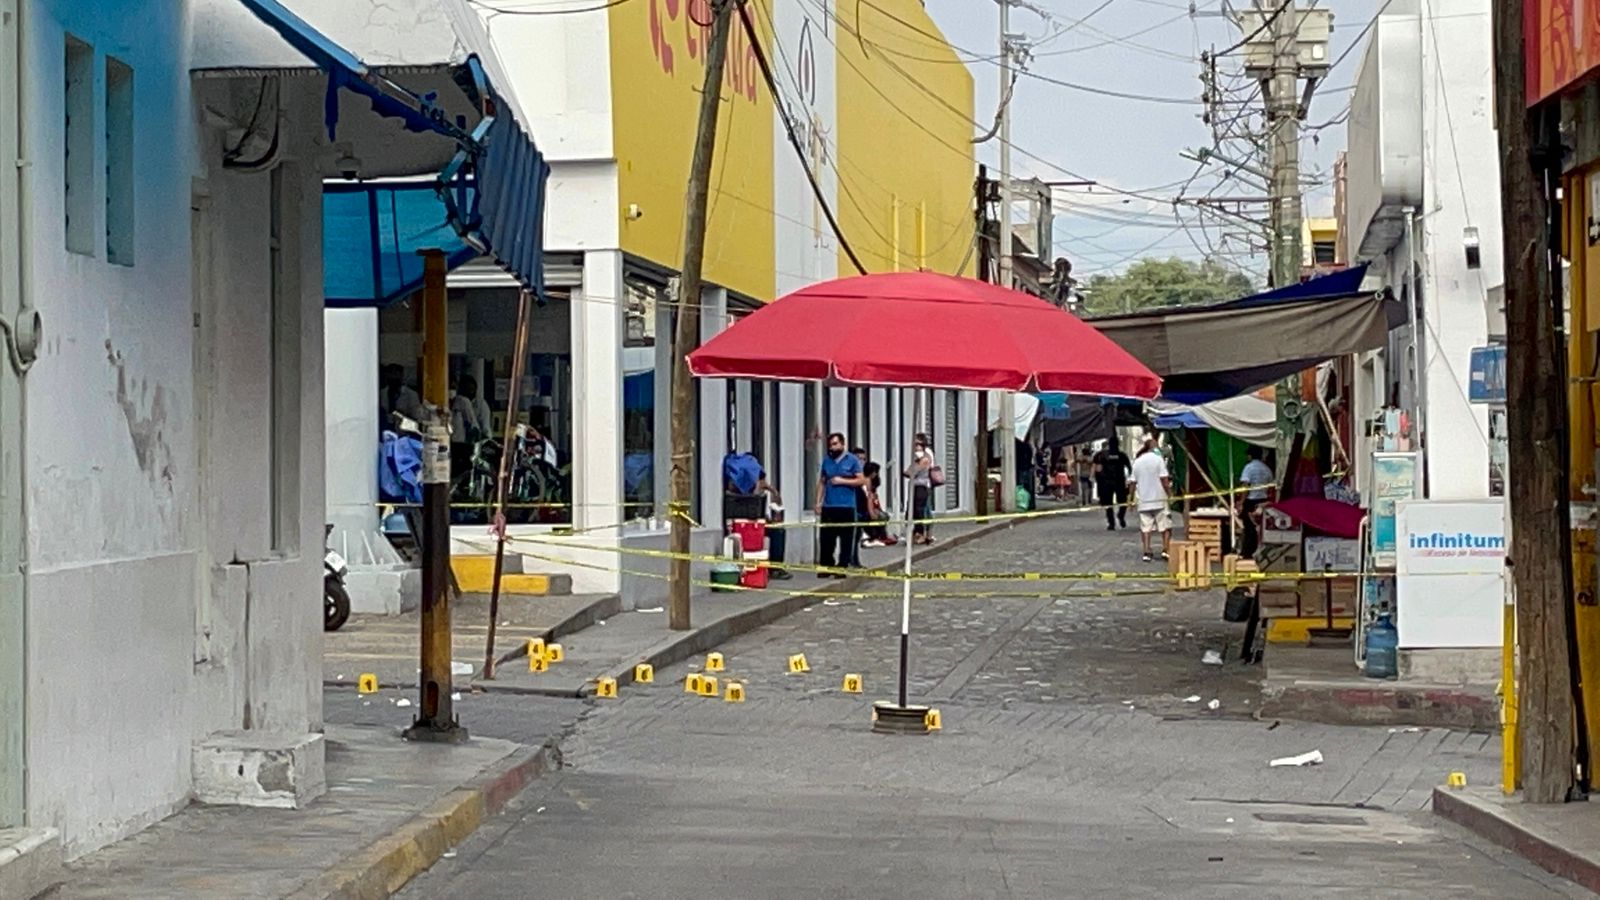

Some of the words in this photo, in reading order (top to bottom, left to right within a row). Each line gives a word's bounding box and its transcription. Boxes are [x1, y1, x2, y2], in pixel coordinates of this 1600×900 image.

[1409, 533, 1505, 548] infinitum
[532, 643, 539, 653] 4
[551, 650, 558, 660] 3
[535, 660, 542, 670] 2
[711, 658, 719, 668] 7
[604, 683, 611, 695] 5
